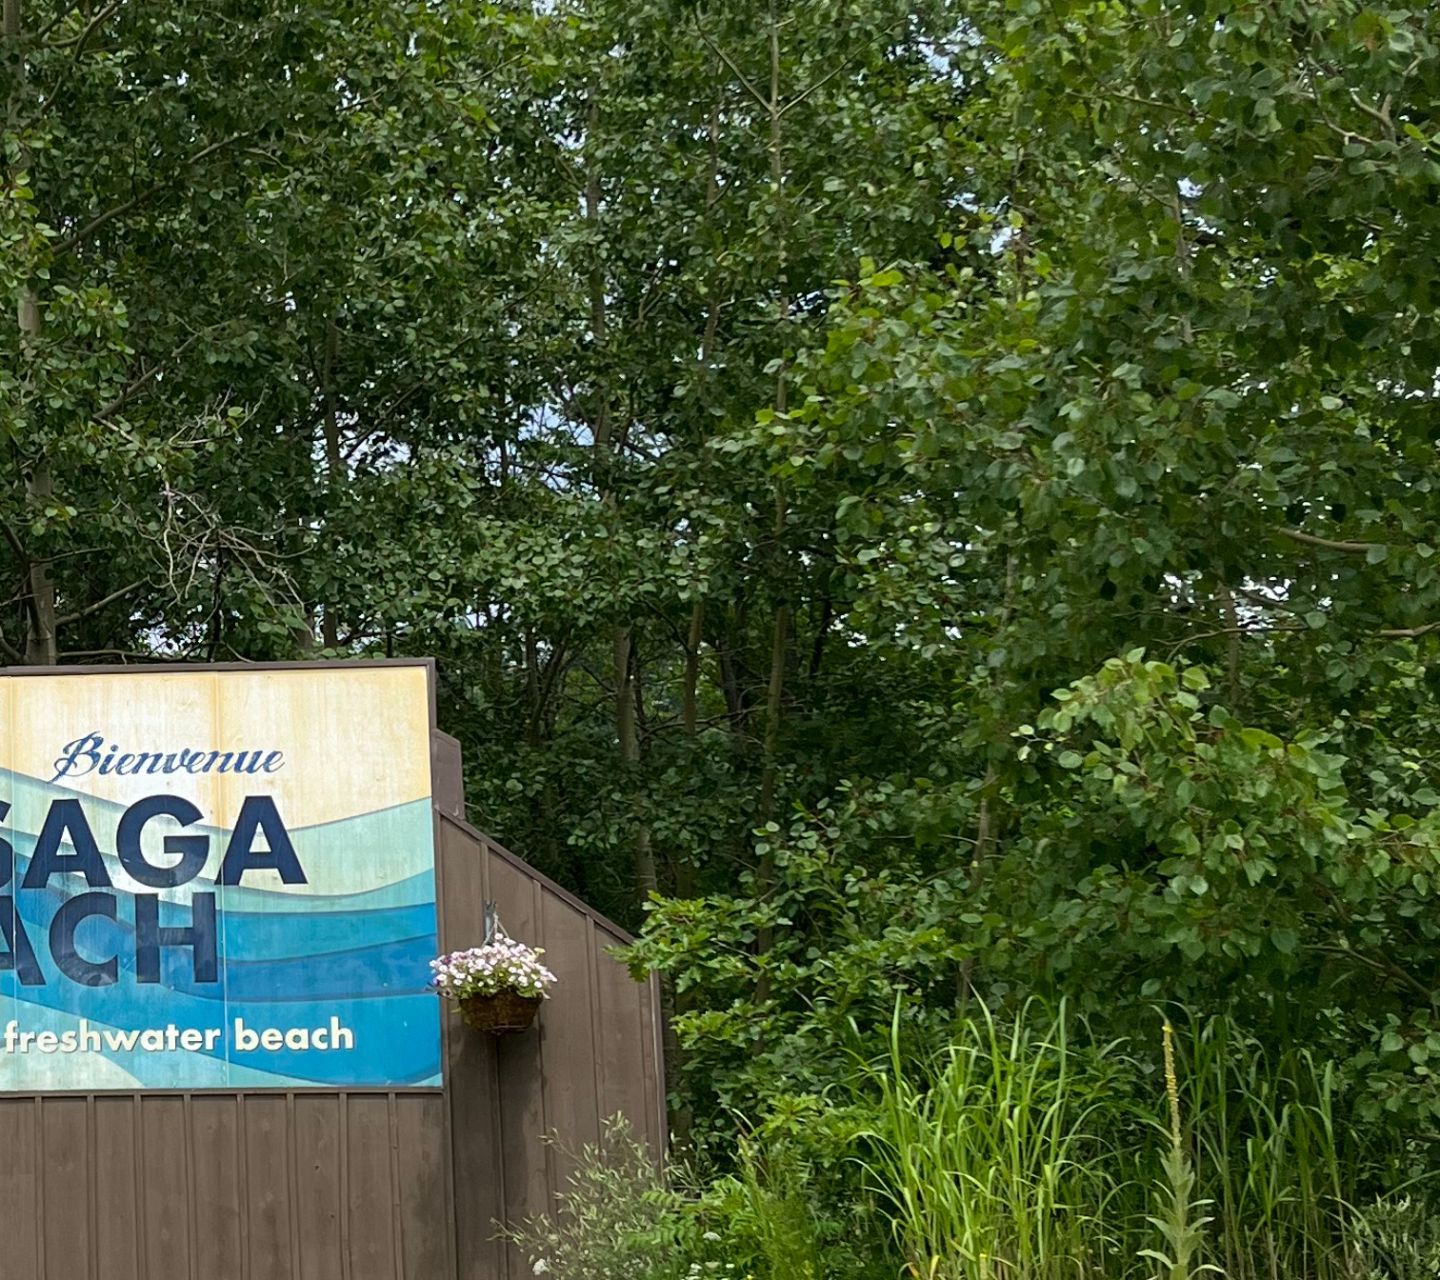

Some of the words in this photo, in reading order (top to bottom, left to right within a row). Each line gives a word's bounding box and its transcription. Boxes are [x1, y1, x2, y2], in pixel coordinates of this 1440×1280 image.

[46, 729, 286, 785] Bienvenue
[3, 1018, 222, 1054] freshwater
[234, 1016, 355, 1052] beach
